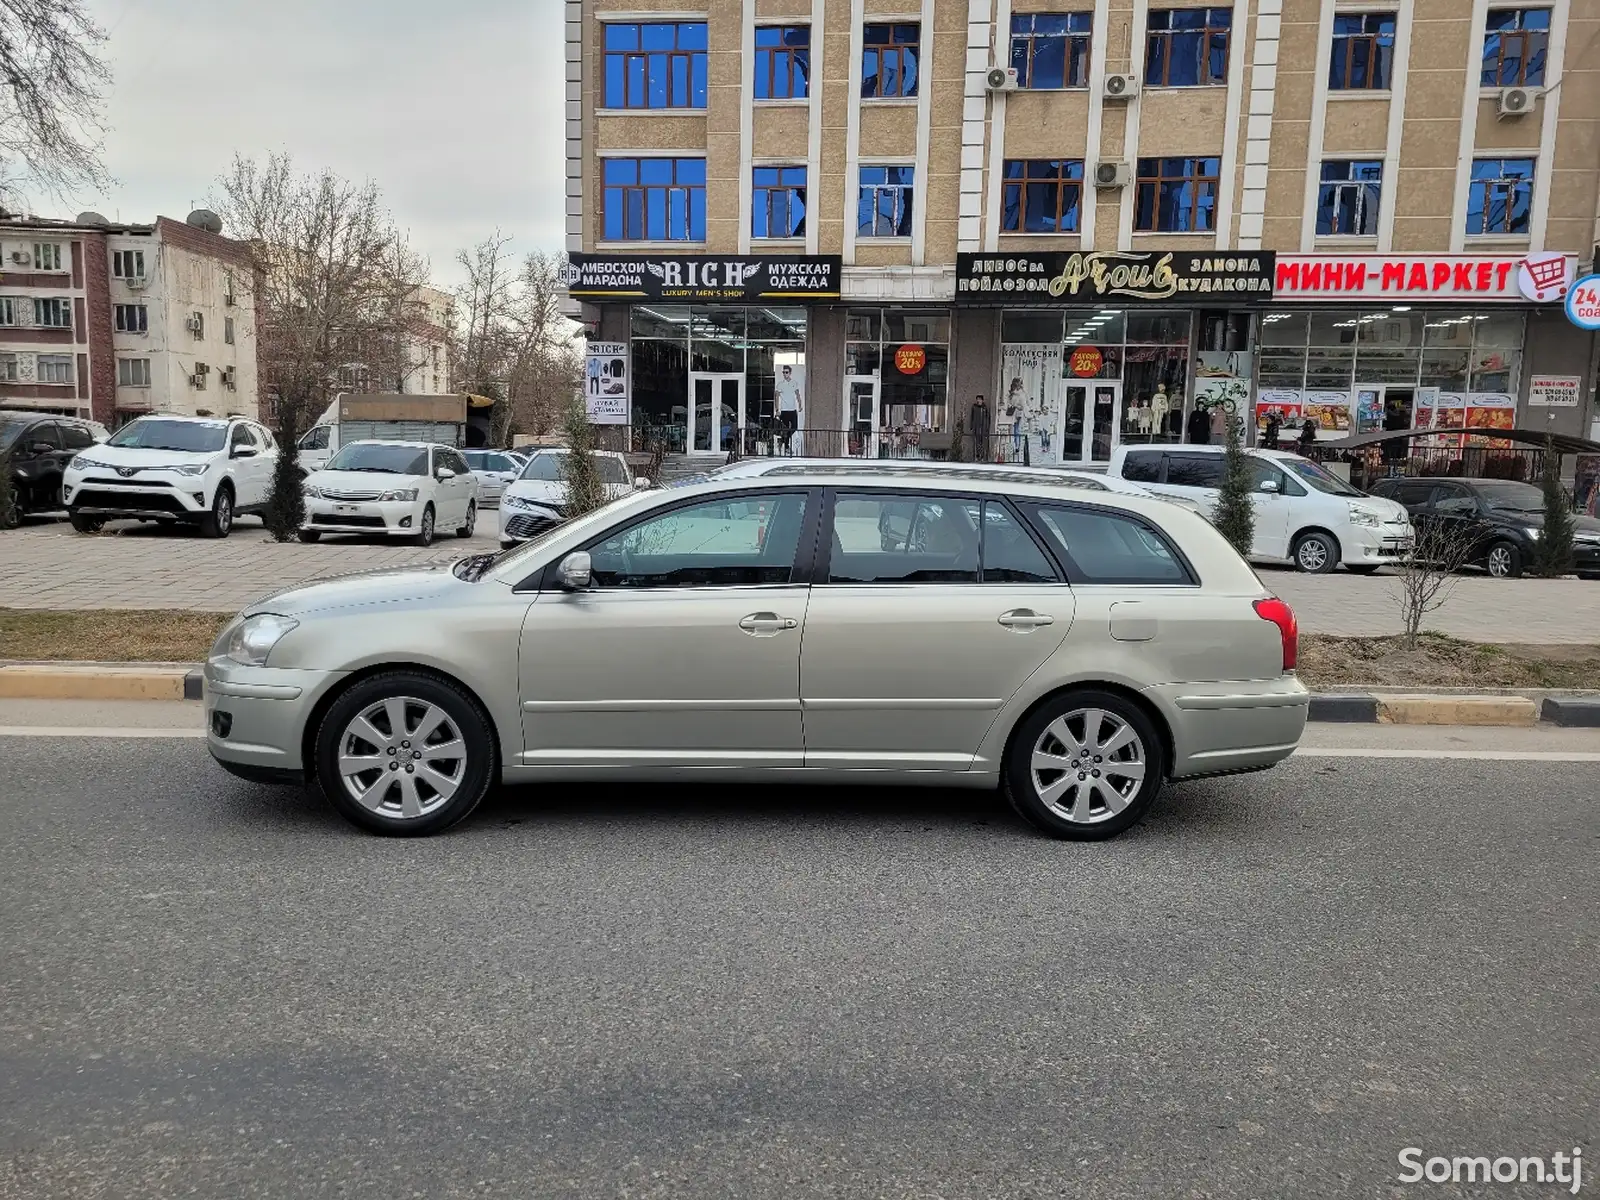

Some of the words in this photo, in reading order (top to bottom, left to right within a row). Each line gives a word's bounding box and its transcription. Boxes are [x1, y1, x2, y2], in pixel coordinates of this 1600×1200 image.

[768, 263, 831, 275] МУЖСКАЯ
[972, 259, 1028, 273] ЛИБОС
[1190, 258, 1261, 272] ЗАНОНА
[661, 261, 745, 287] RICH
[1276, 262, 1511, 291] МИНИ-МАРКЕТ
[583, 275, 642, 287] МАРДОНА
[769, 276, 828, 289] ОДЕЖДА
[959, 276, 1049, 292] ПОЙАФЗОЛ
[593, 344, 619, 353] RICH
[900, 357, 921, 369] 20%
[1074, 360, 1098, 371] 20%
